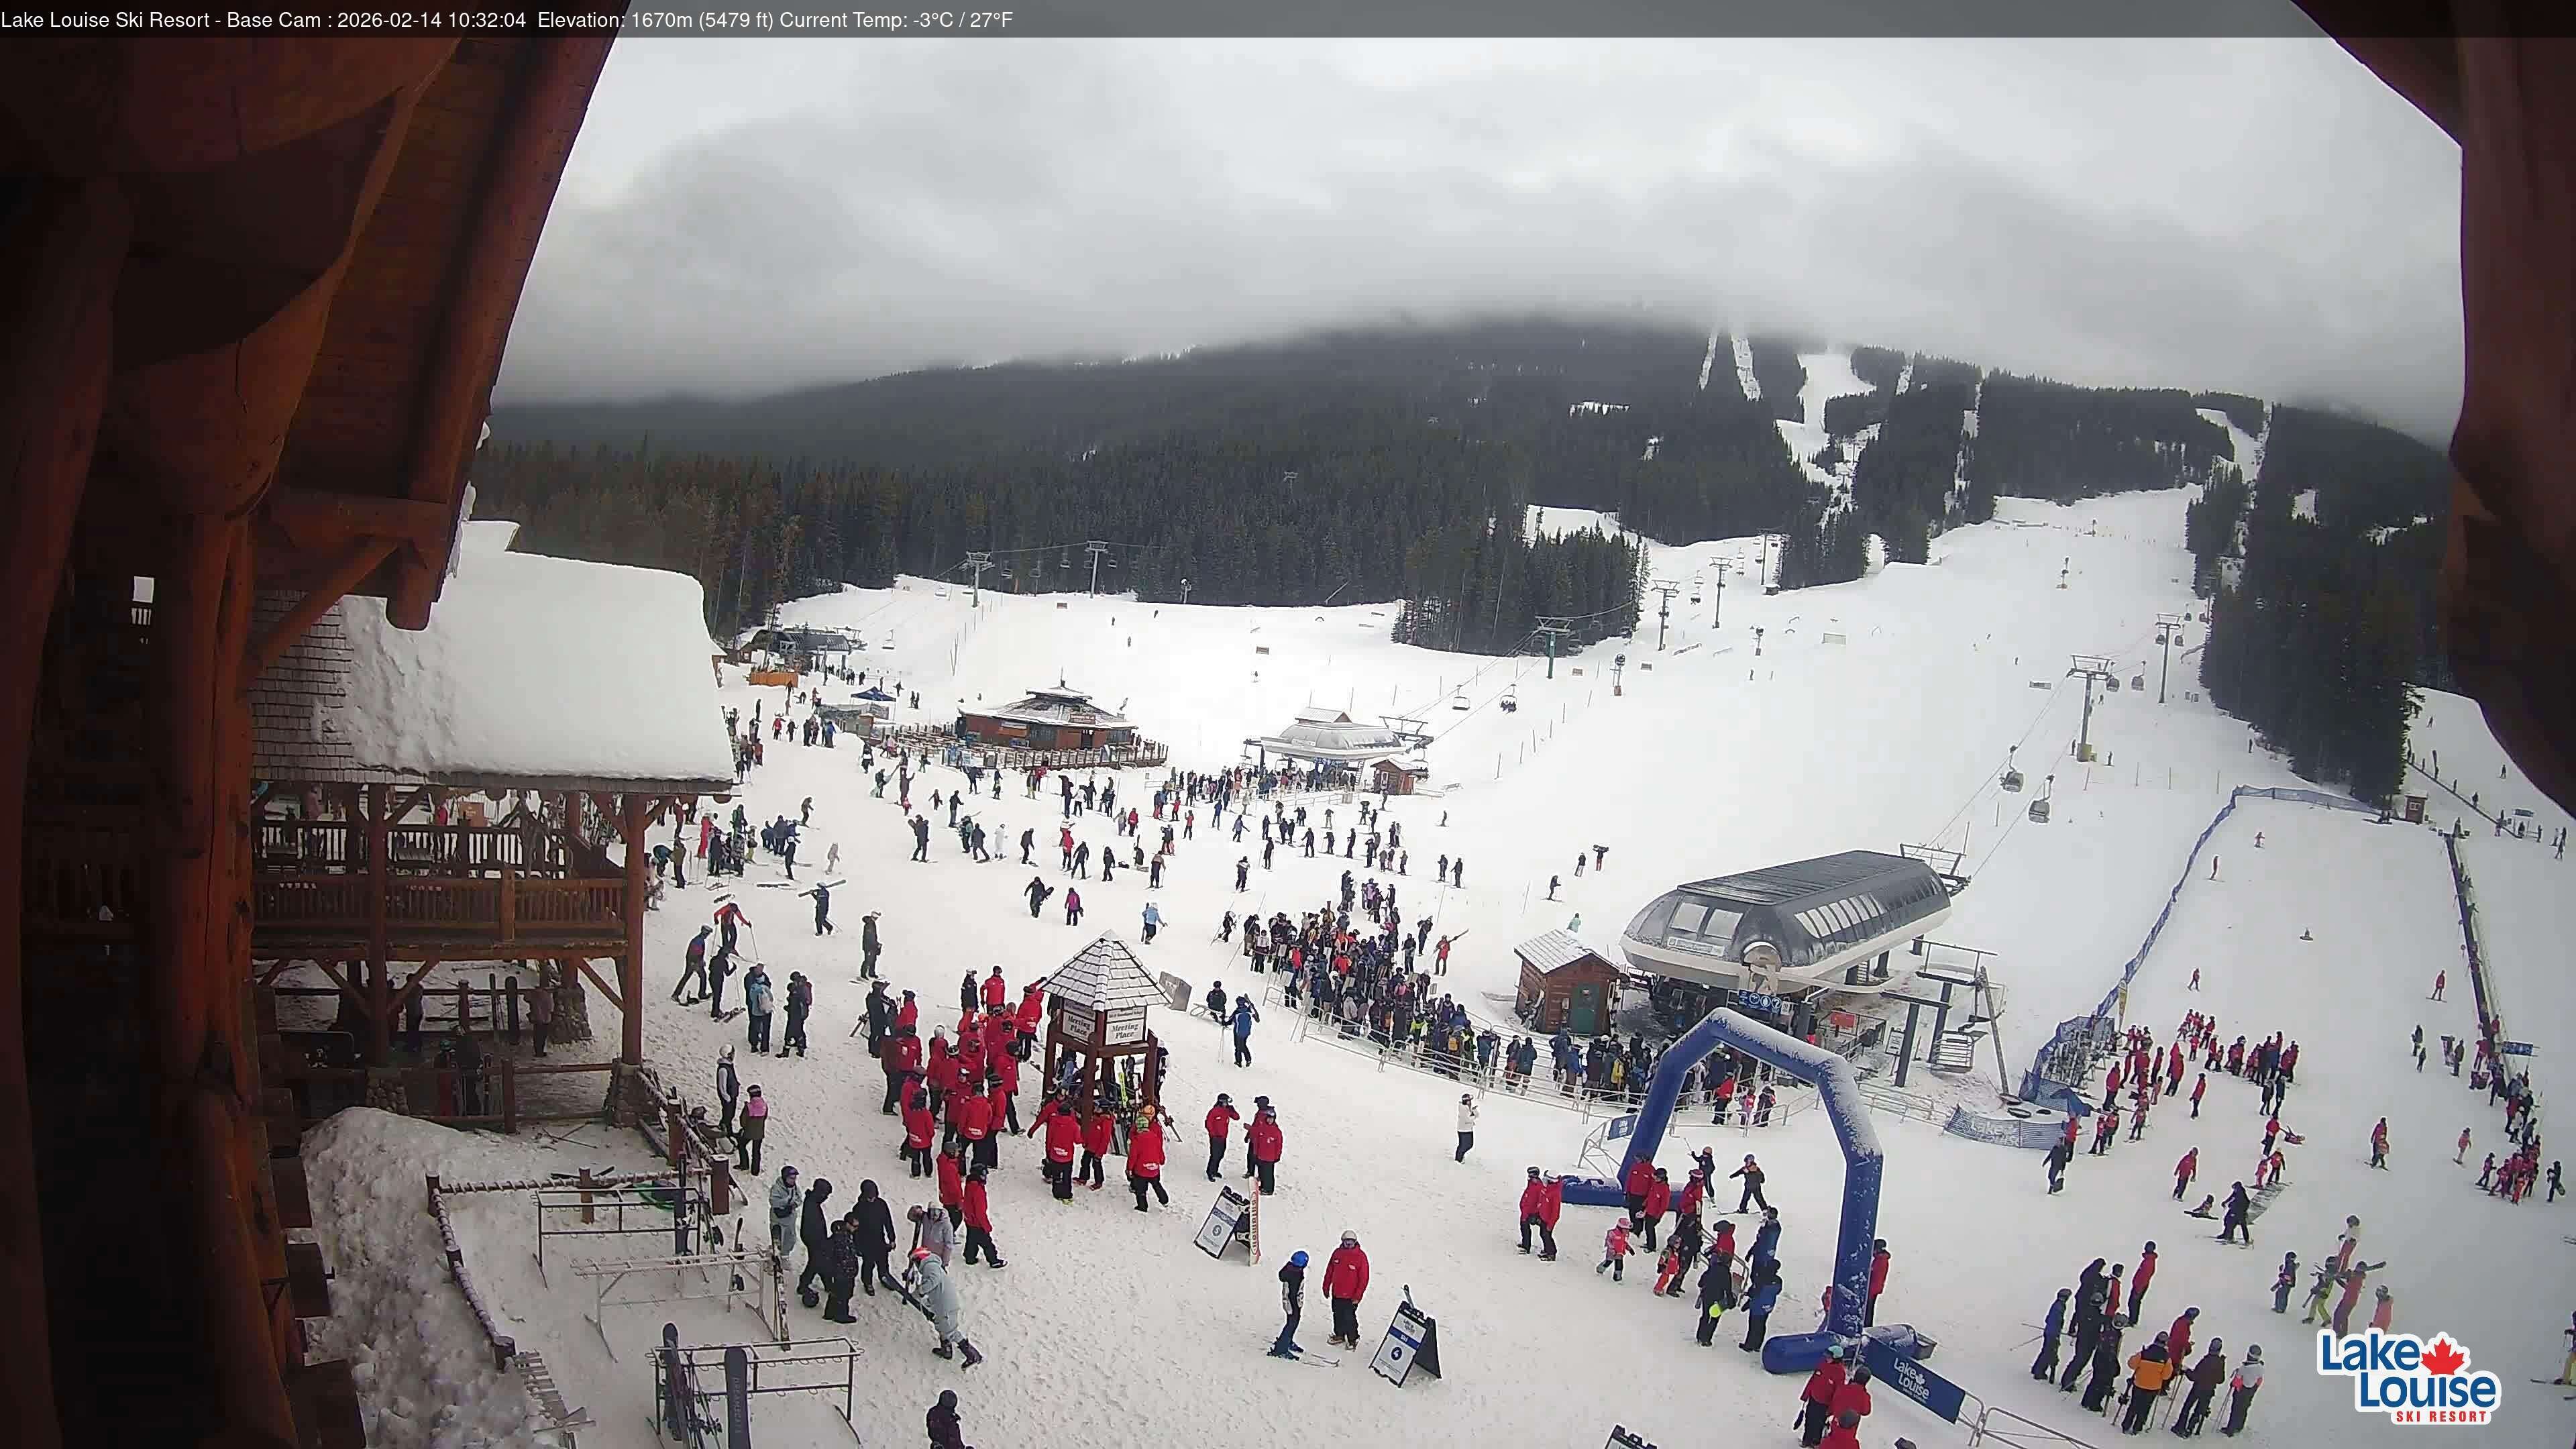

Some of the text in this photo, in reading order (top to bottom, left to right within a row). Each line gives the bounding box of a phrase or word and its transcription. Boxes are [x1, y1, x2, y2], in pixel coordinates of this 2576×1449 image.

[1112, 1024, 1138, 1032] Meeting
[1894, 1357, 1917, 1379] Lake
[1898, 1373, 1930, 1400] Louise
